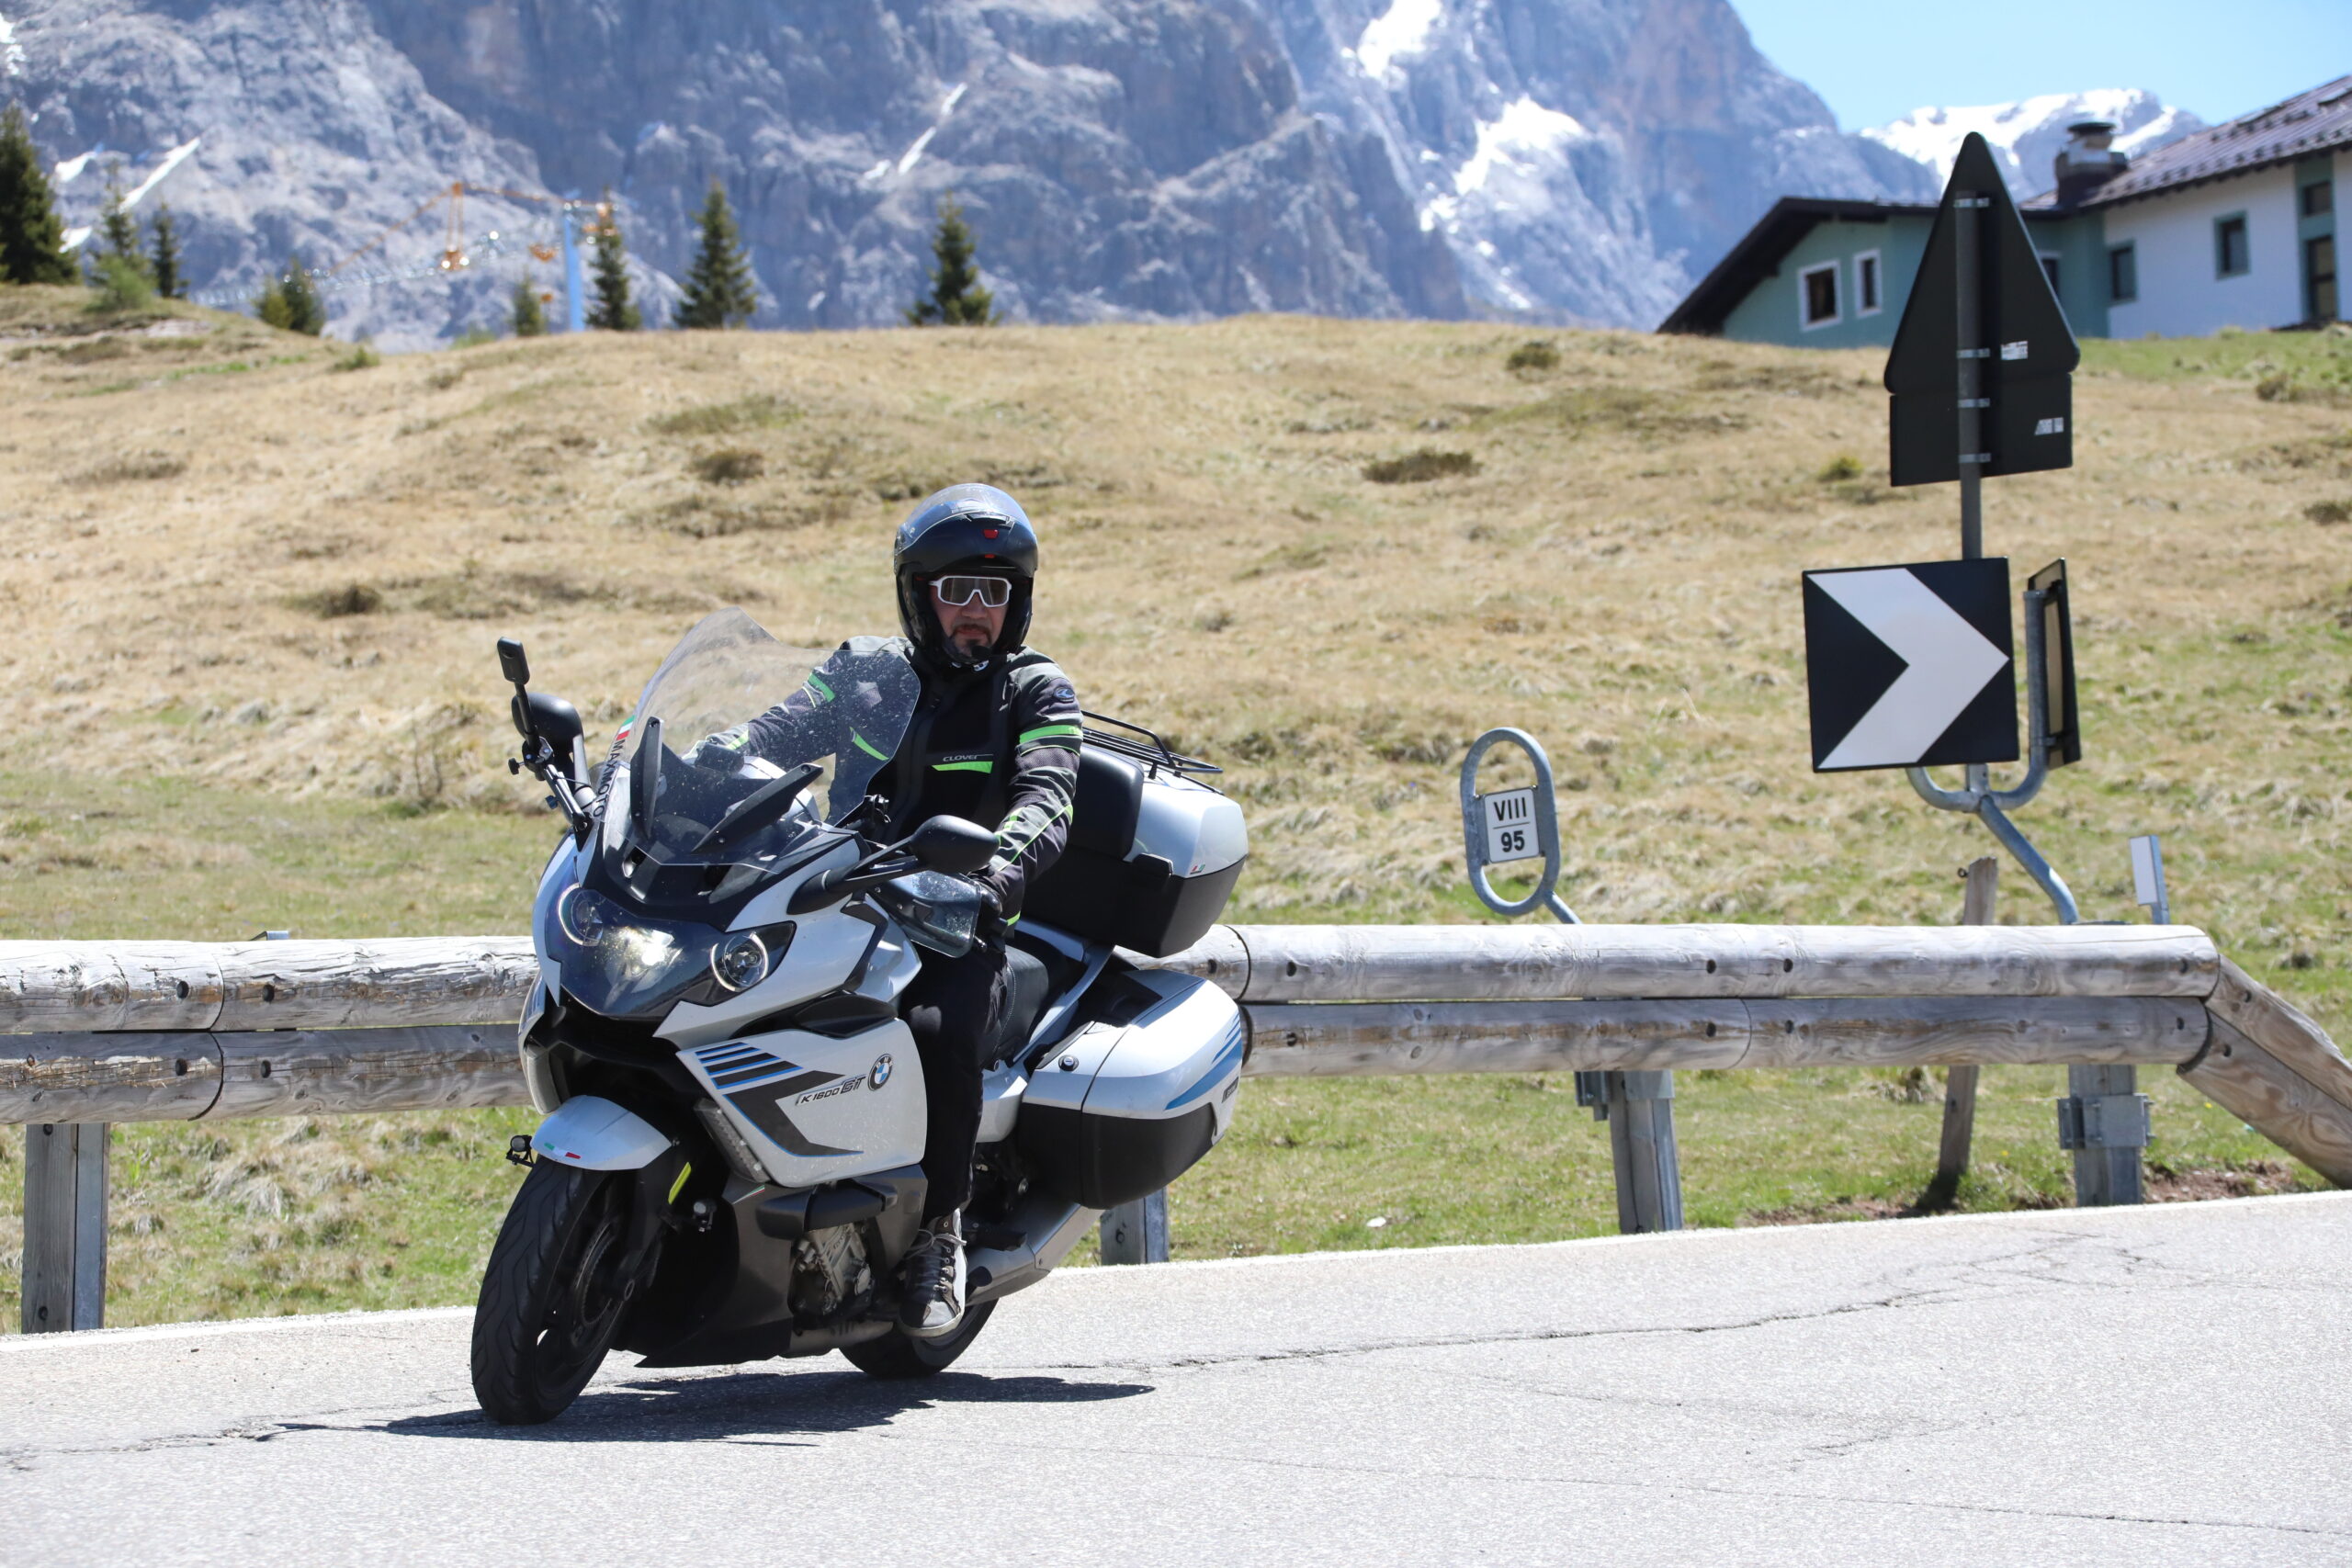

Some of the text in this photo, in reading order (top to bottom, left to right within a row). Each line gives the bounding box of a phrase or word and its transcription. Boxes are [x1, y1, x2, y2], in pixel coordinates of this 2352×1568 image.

[594, 739, 625, 817] MAXMOTO
[1493, 797, 1527, 821] VIII
[1501, 830, 1525, 852] 95
[812, 1088, 840, 1100] 1600
[840, 1076, 866, 1094] GT
